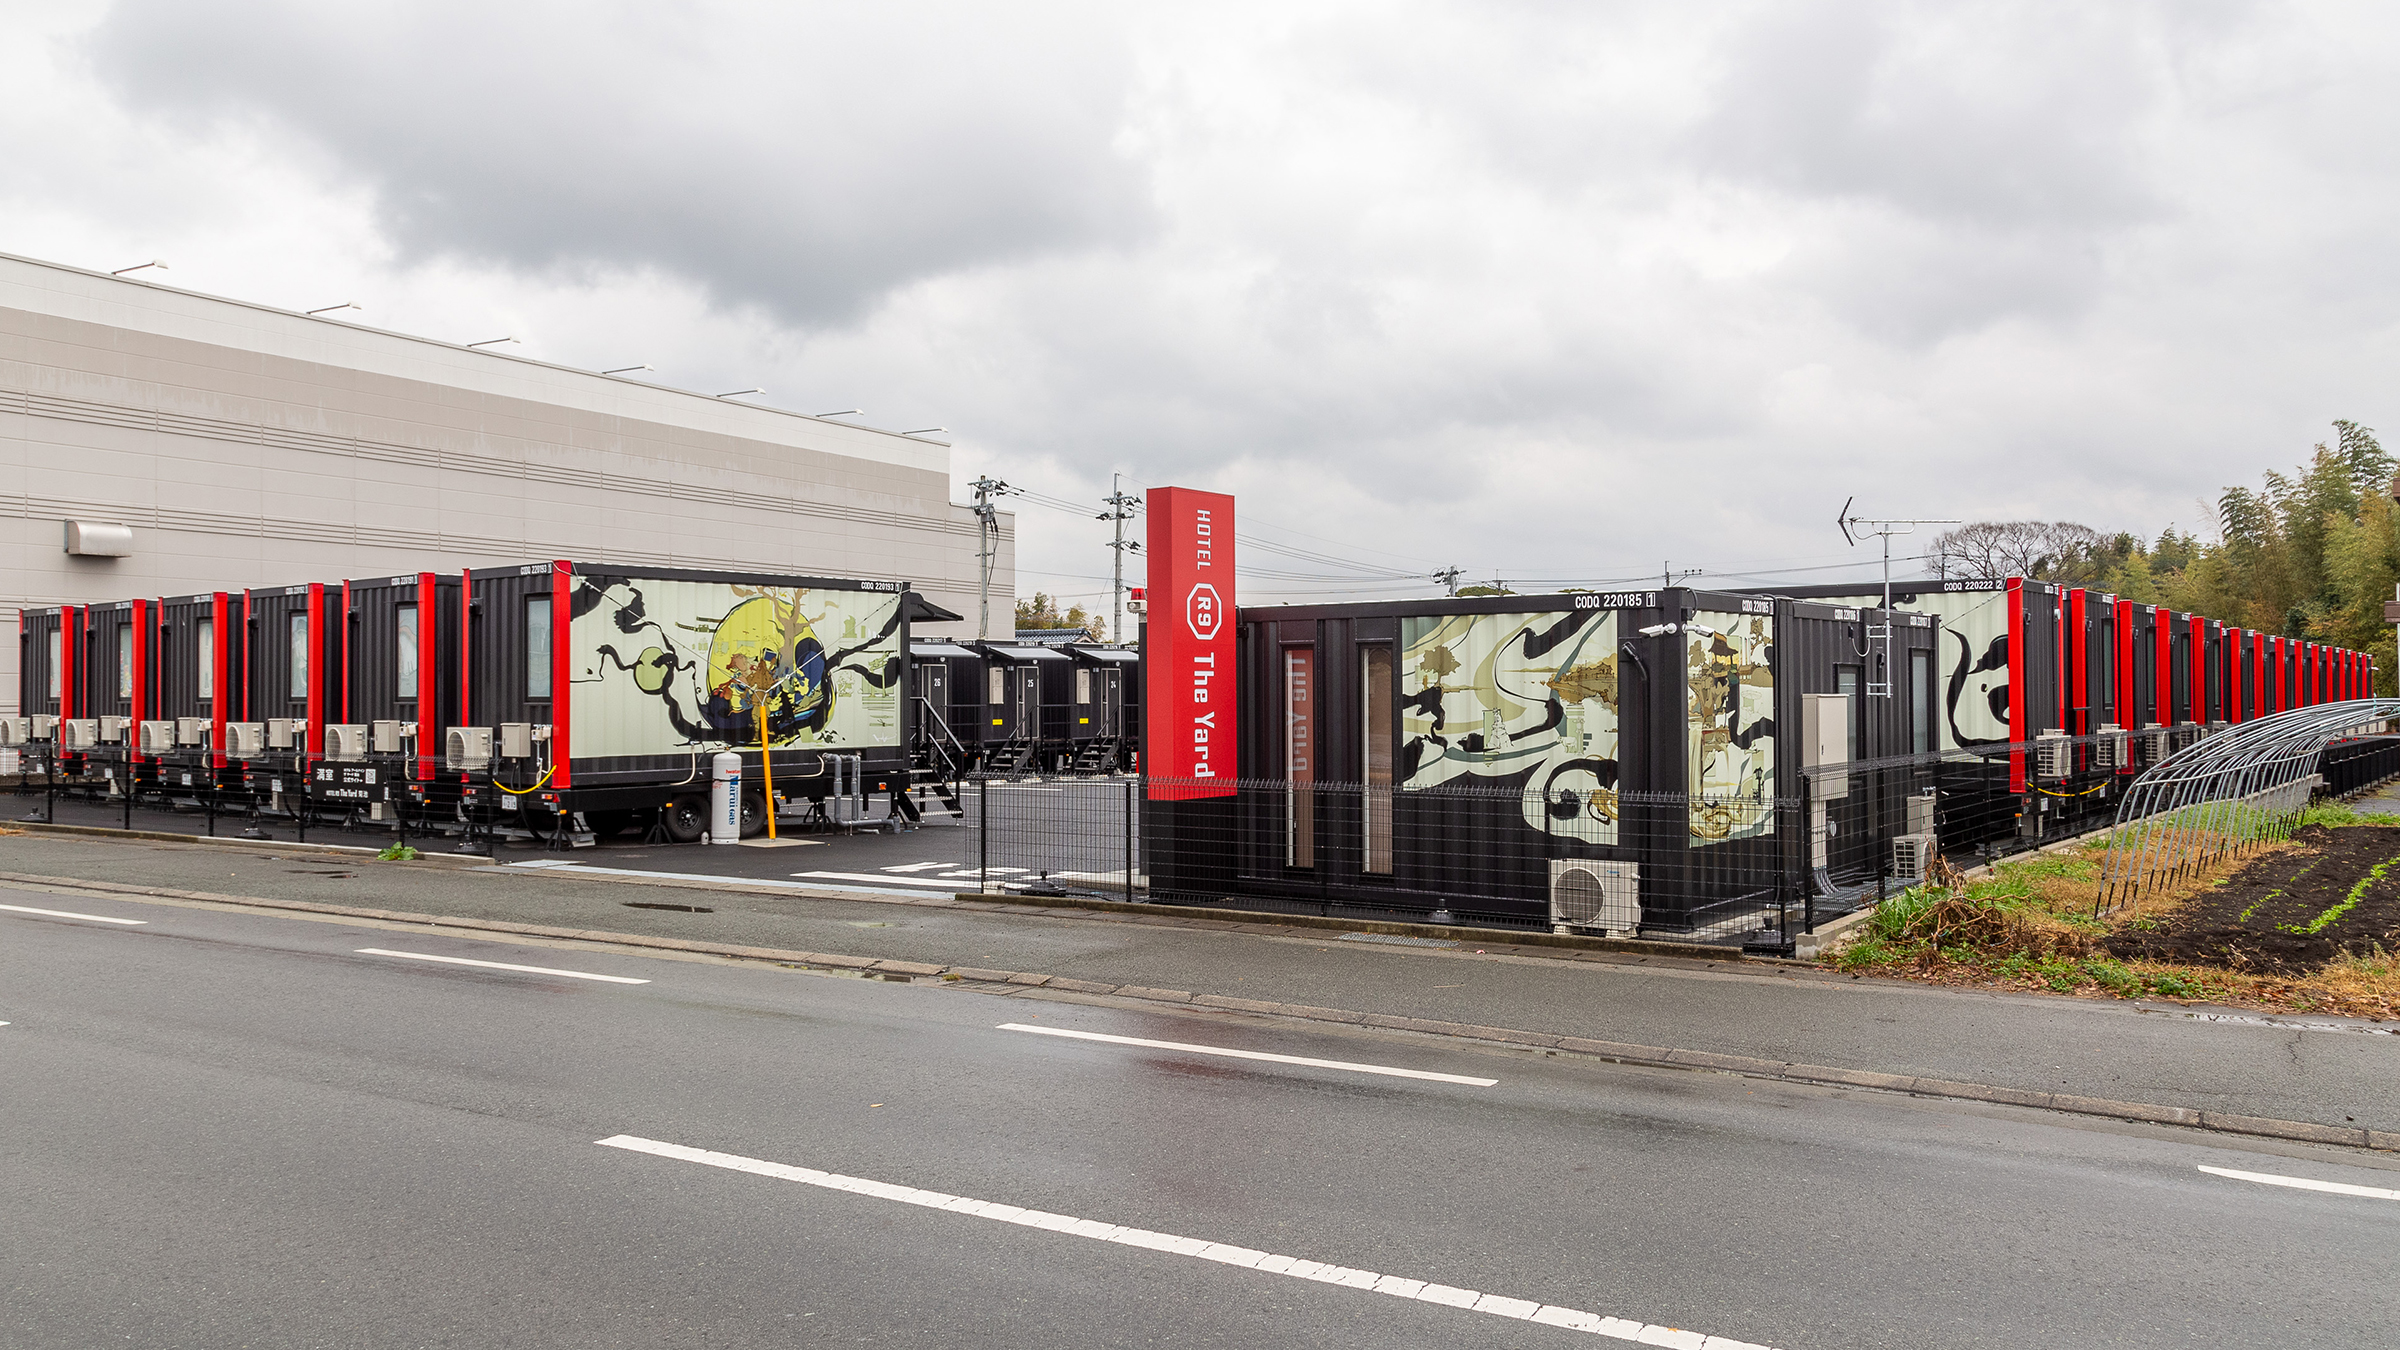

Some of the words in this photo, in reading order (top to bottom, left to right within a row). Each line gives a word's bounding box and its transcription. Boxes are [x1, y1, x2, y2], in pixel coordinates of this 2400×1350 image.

[1197, 509, 1211, 571] HOTEL
[861, 582, 874, 590] CODQ
[875, 582, 894, 590] 220193
[1944, 582, 1962, 591] CODQ
[1965, 581, 1993, 590] 220222
[1575, 595, 1600, 609] CODQ
[1603, 593, 1642, 607] 220185
[1646, 592, 1656, 607] 1
[1197, 596, 1212, 627] R9
[934, 678, 941, 687] 26
[1027, 679, 1034, 688] 25
[1194, 652, 1215, 703] The
[1110, 681, 1116, 689] 24
[1194, 711, 1215, 778] Yard
